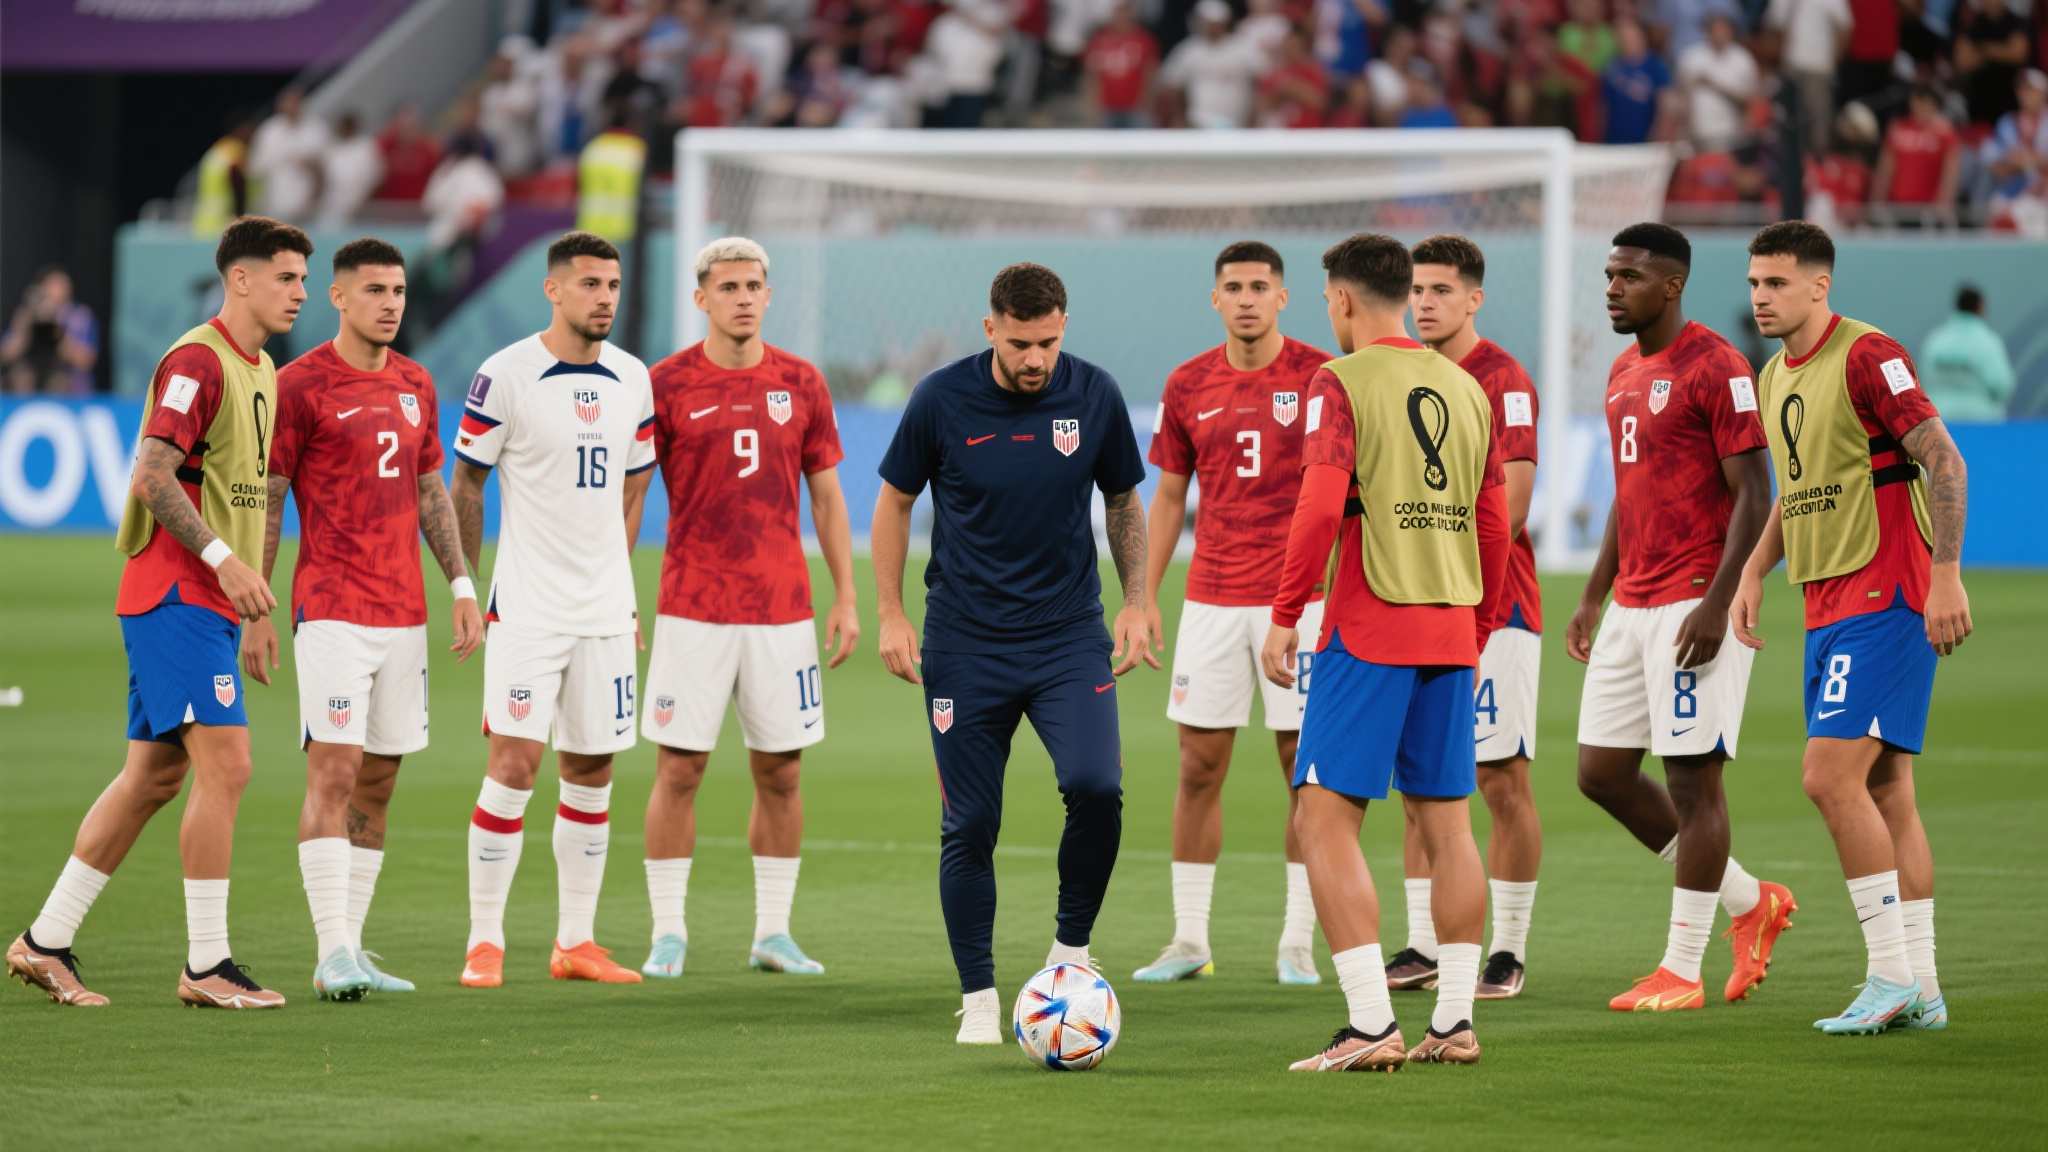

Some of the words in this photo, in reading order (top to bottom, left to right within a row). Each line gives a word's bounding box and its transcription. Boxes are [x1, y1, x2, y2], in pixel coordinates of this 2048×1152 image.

[377, 431, 400, 478] 2
[734, 429, 759, 478] 9
[1236, 430, 1261, 478] 3
[1620, 415, 1638, 463] 8
[576, 445, 607, 488] 16
[796, 664, 820, 711] 10
[1674, 671, 1697, 718] 8
[1823, 654, 1851, 703] 8
